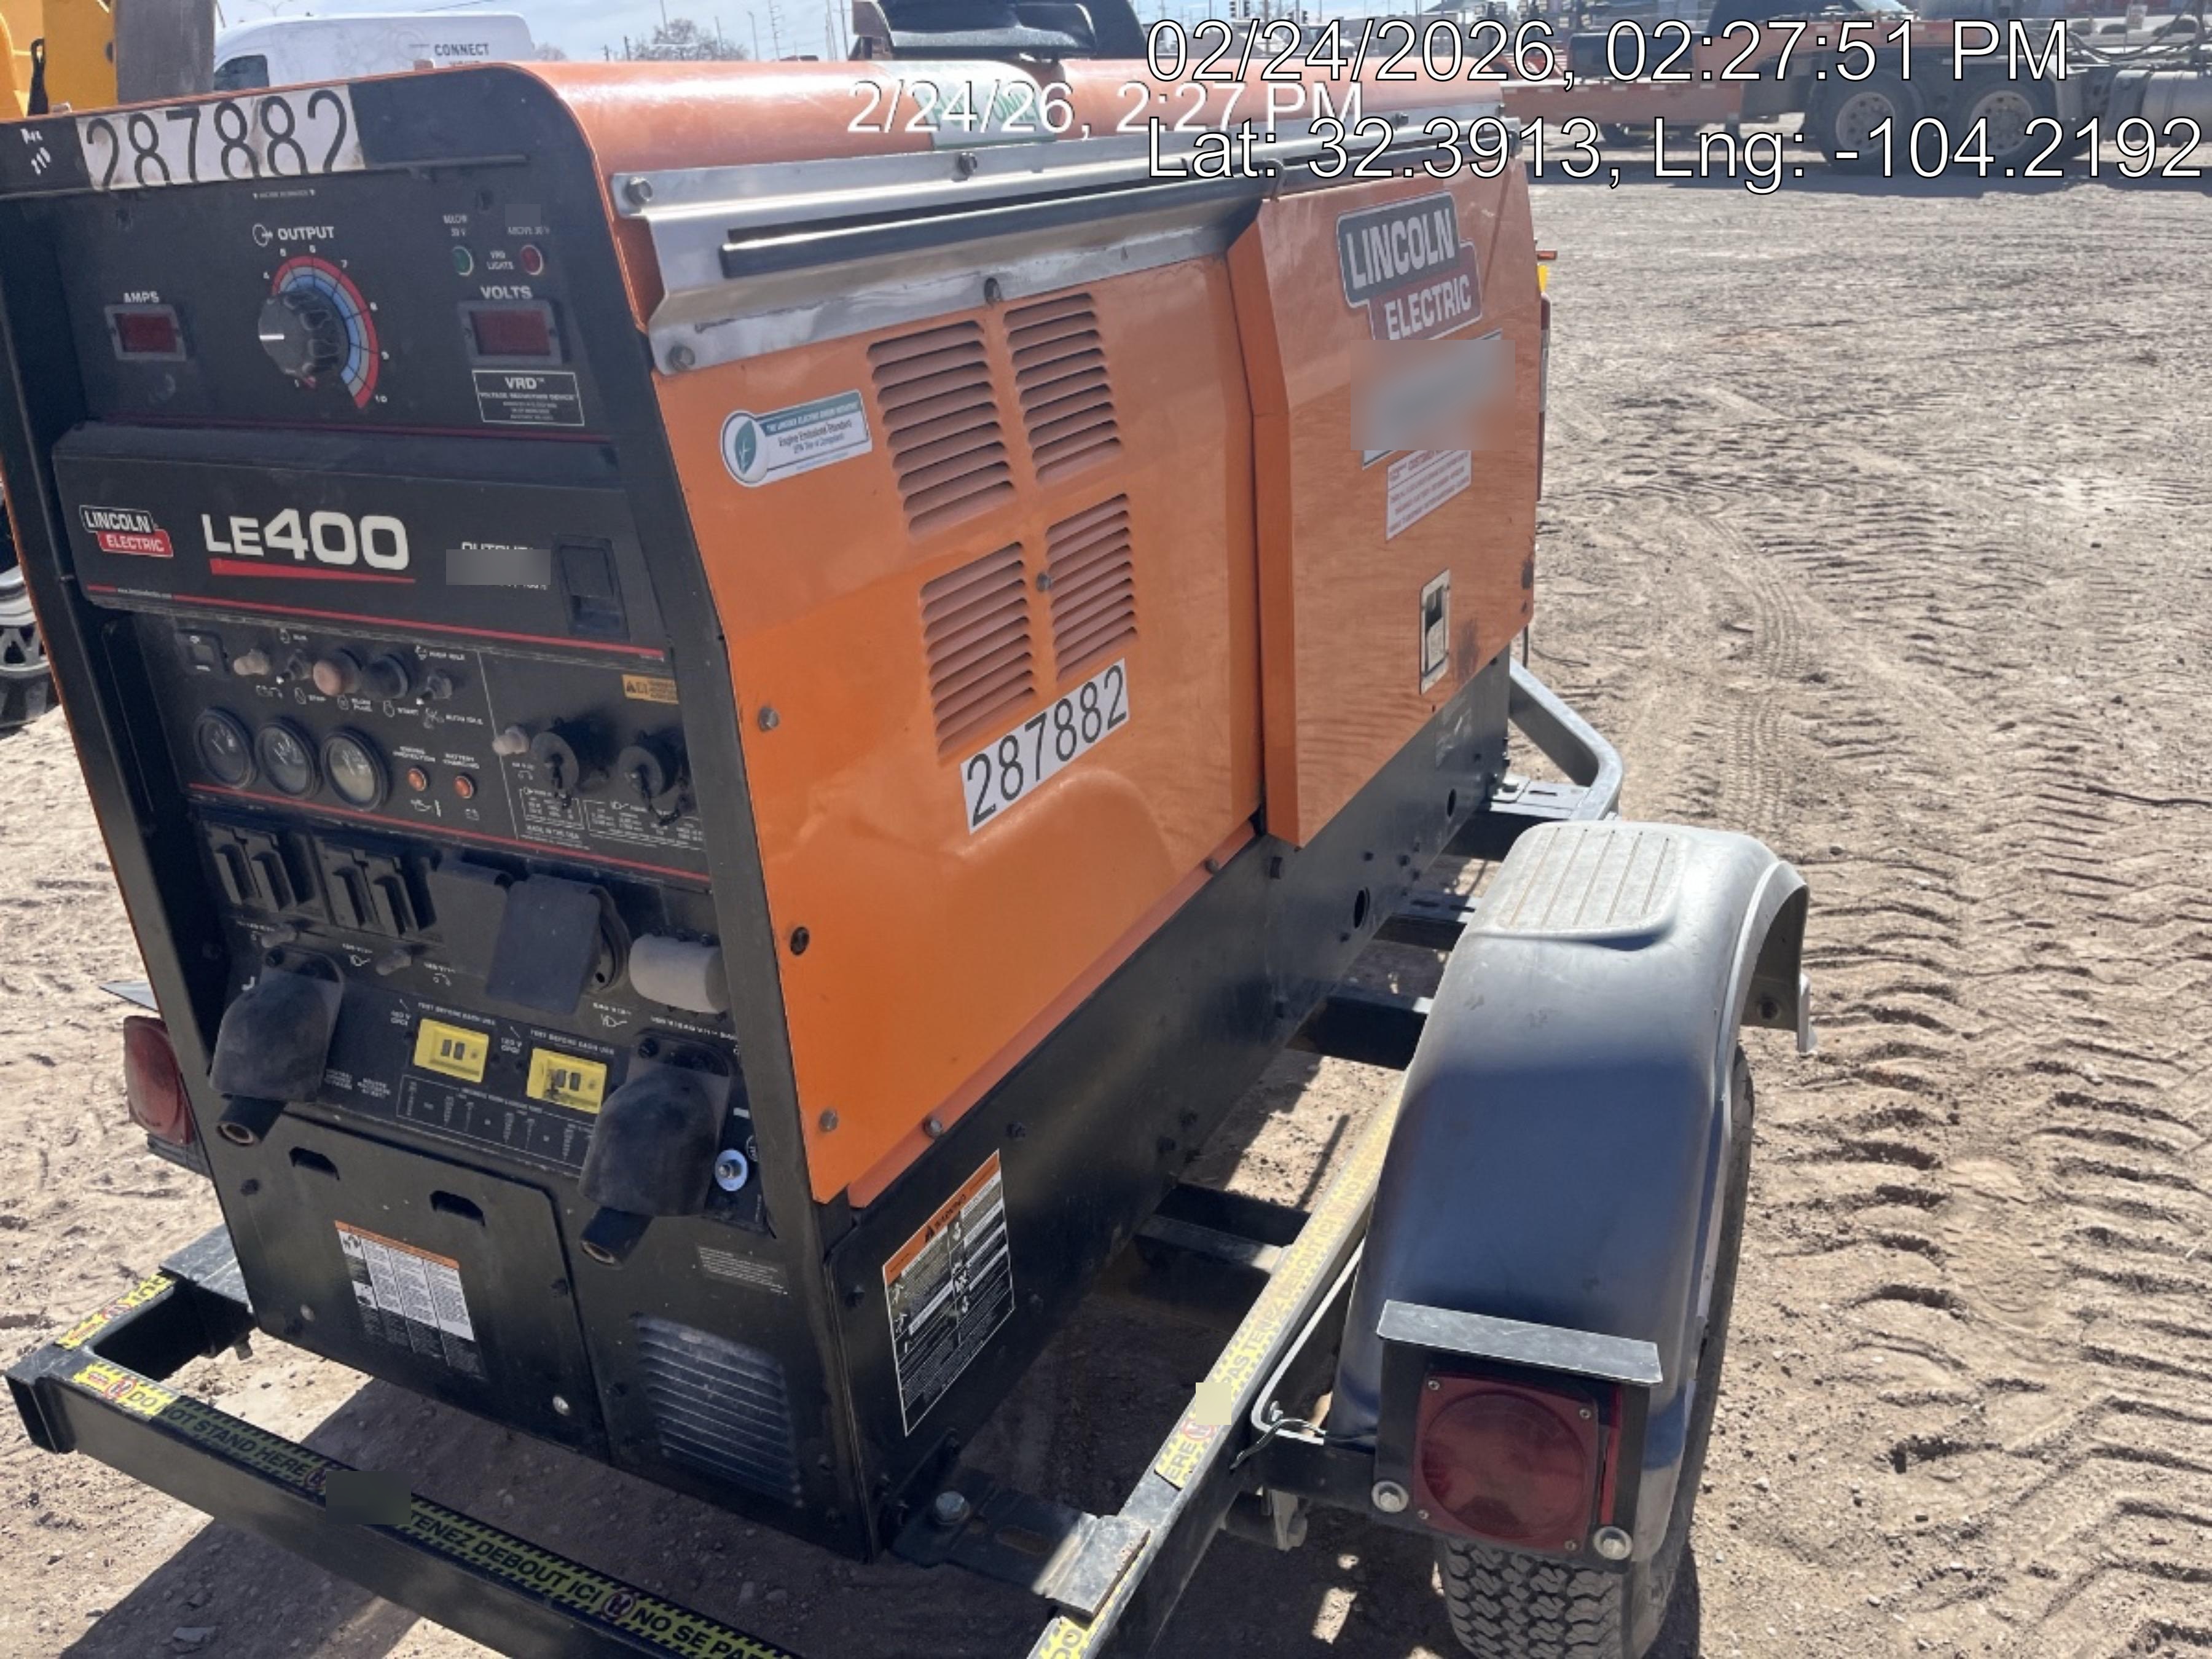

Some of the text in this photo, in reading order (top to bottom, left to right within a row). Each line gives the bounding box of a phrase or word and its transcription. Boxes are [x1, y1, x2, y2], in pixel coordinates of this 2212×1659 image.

[434, 44, 490, 56] CONNECT
[86, 89, 347, 187] 287882
[278, 226, 335, 240] OUTPUT
[1345, 207, 1456, 290] LINCOLN
[124, 291, 160, 304] AMPS
[480, 285, 533, 299] VOLTS
[1384, 273, 1473, 339] ELECTRIC
[84, 510, 151, 532] LINCOLN
[106, 535, 165, 553] ELECTRIC
[201, 508, 410, 571] LE400
[968, 665, 1127, 828] 287882
[125, 1390, 159, 1408] DO
[192, 1419, 257, 1453] STAND
[254, 1446, 313, 1477] HERE
[471, 1540, 571, 1588] DEBOUT
[565, 1580, 605, 1604] ICI
[630, 1607, 672, 1632] NO
[672, 1625, 712, 1650] SE
